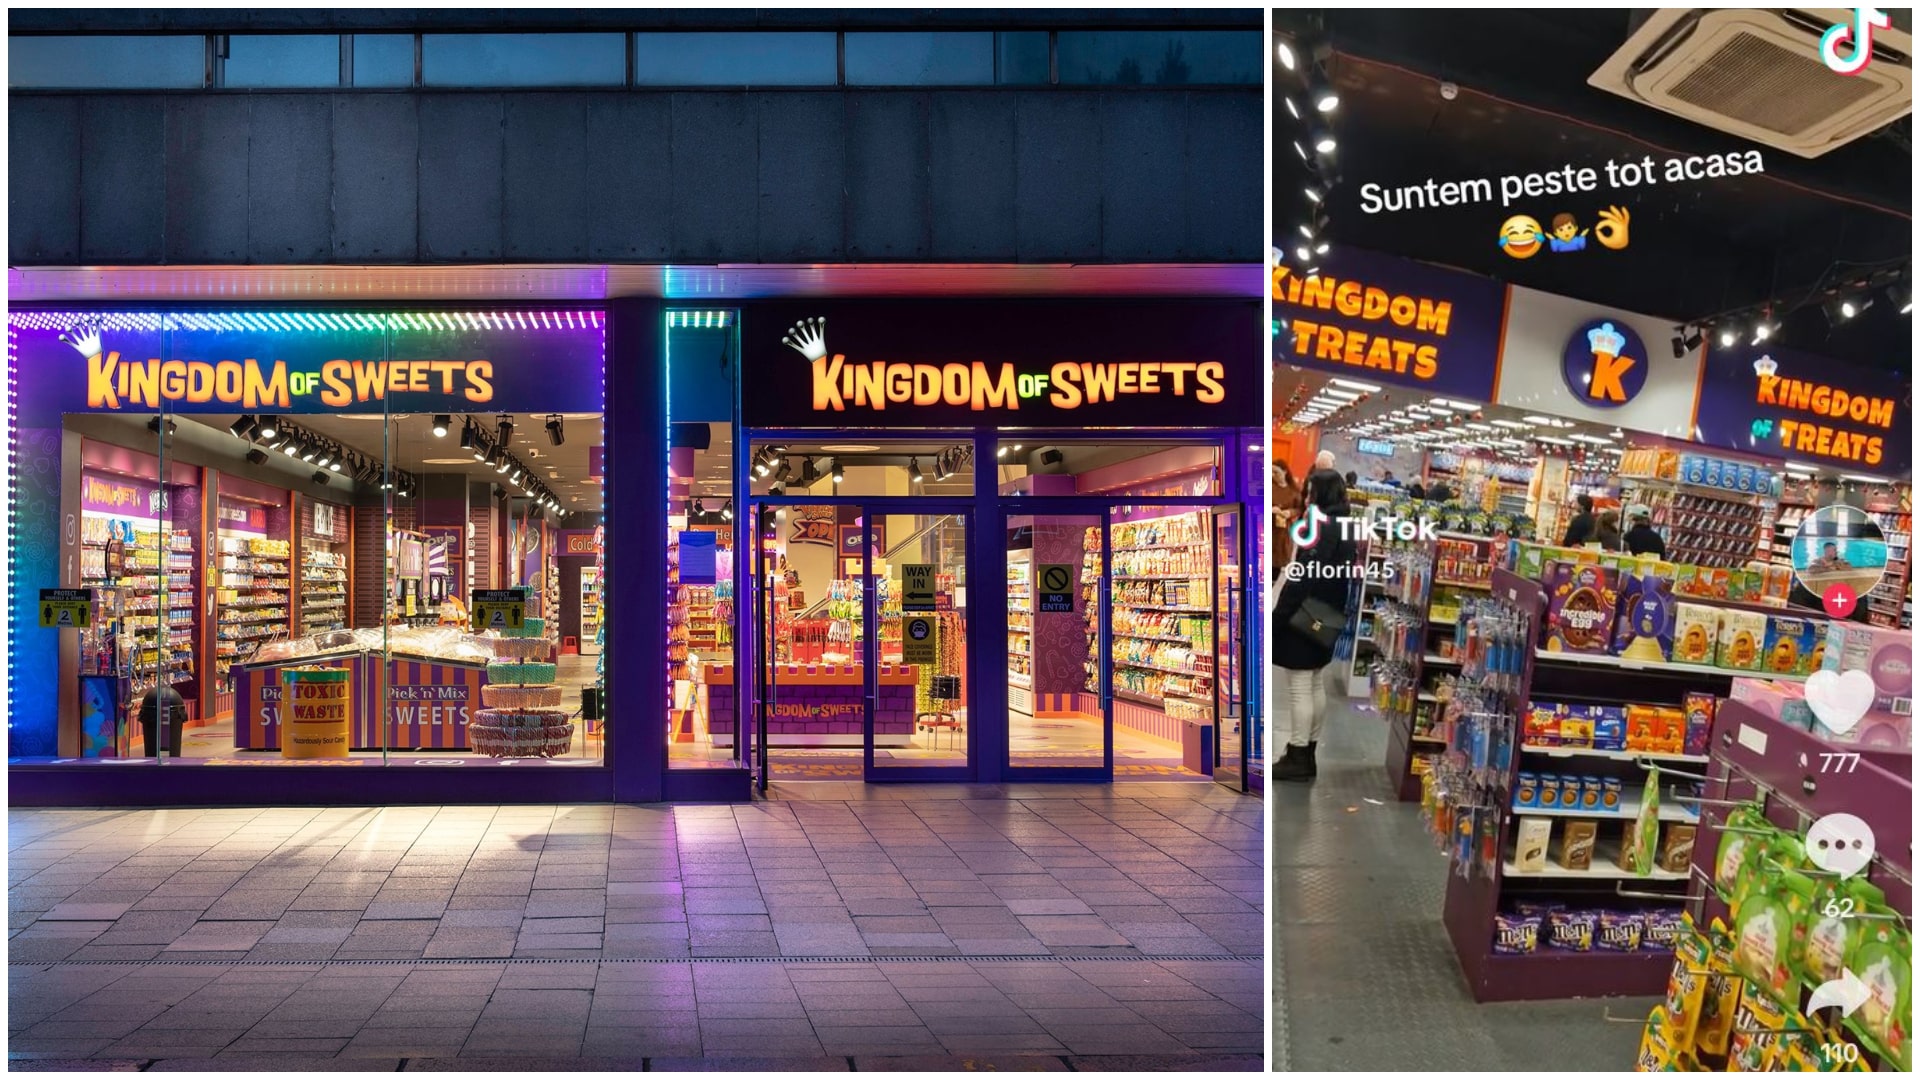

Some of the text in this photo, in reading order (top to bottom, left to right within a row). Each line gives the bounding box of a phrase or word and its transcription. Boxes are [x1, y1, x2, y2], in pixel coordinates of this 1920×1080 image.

[1293, 320, 1438, 378] TREATS
[87, 351, 493, 409] KINGDOM OF SWEETS
[1590, 350, 1636, 400] K
[812, 354, 1225, 411] KINGDOM OF SWEETS
[1757, 374, 1895, 428] KINGDOM
[1752, 419, 1883, 464] OF TREATS
[571, 537, 593, 550] Cold
[905, 567, 932, 576] WAY
[913, 579, 925, 588] IN
[61, 610, 69, 620] 2
[494, 611, 502, 621] 2
[292, 685, 345, 699] TOXIC
[387, 687, 418, 700] Pick
[438, 687, 466, 699] Mix
[293, 704, 345, 719] WASTE
[385, 706, 470, 725] SWEETS
[766, 704, 812, 718] NGDOM
[820, 704, 864, 718] SWEET
